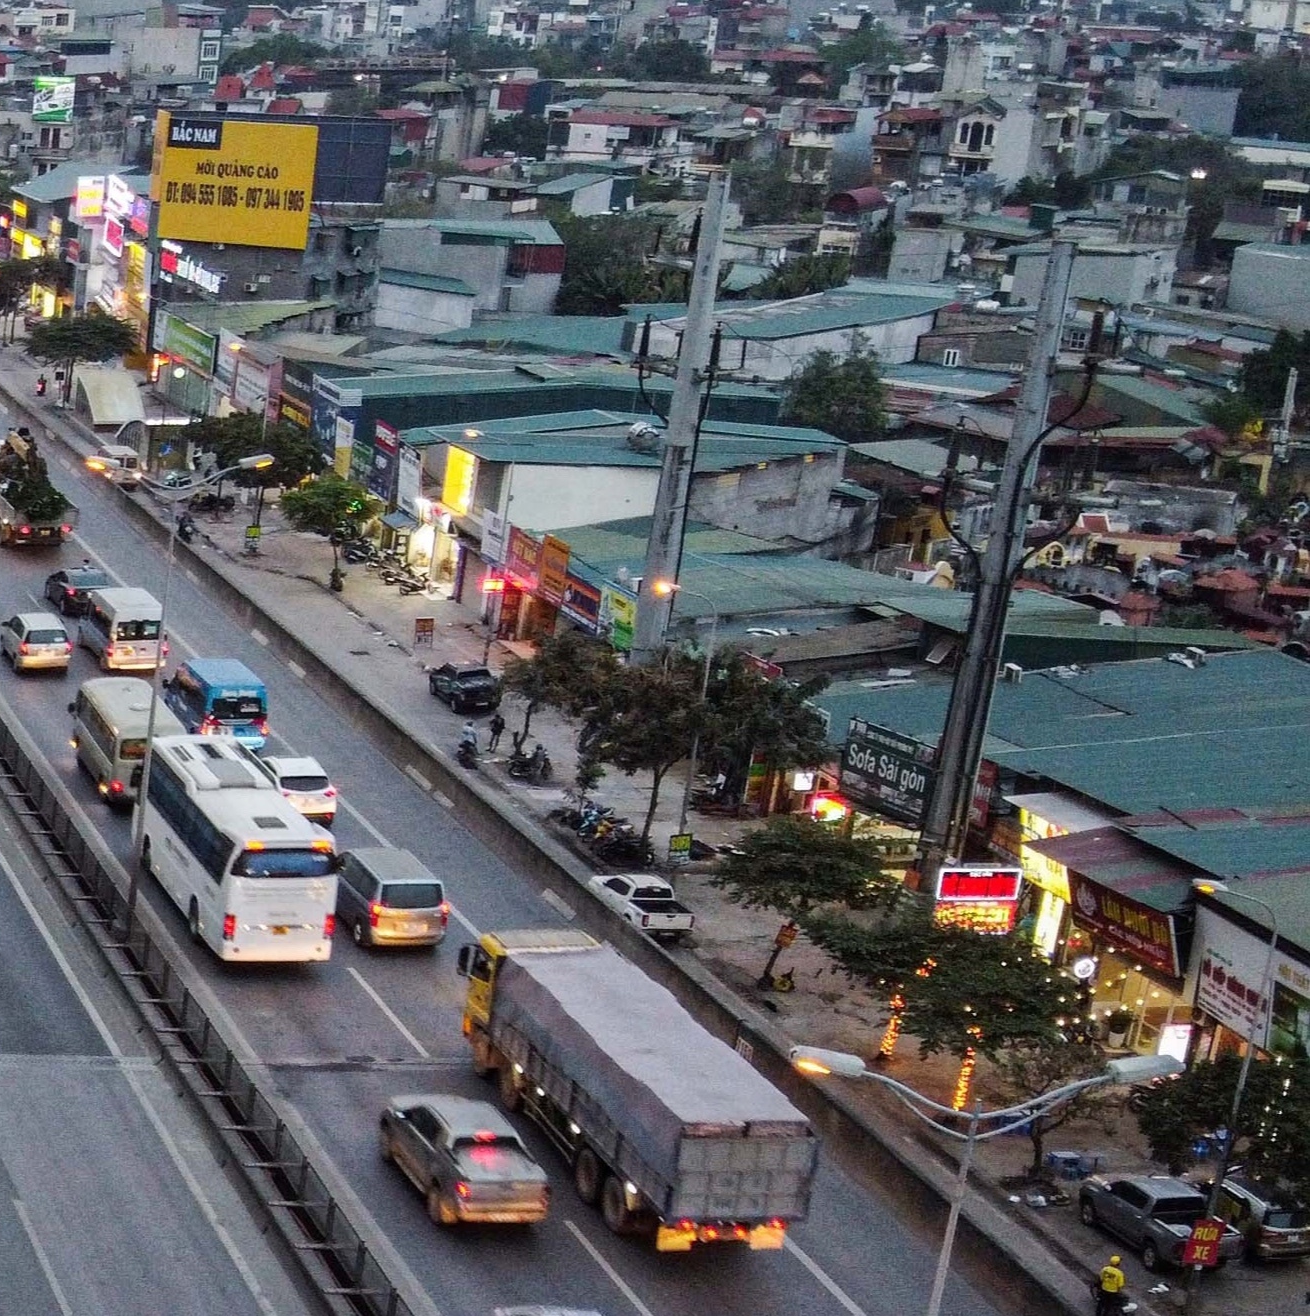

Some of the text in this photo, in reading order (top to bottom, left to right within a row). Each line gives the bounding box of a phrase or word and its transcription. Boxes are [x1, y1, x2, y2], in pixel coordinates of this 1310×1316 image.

[172, 121, 217, 143] BẮC NAM
[199, 184, 215, 205] 555
[848, 743, 875, 773] Sofa
[1192, 1246, 1211, 1261] XE
